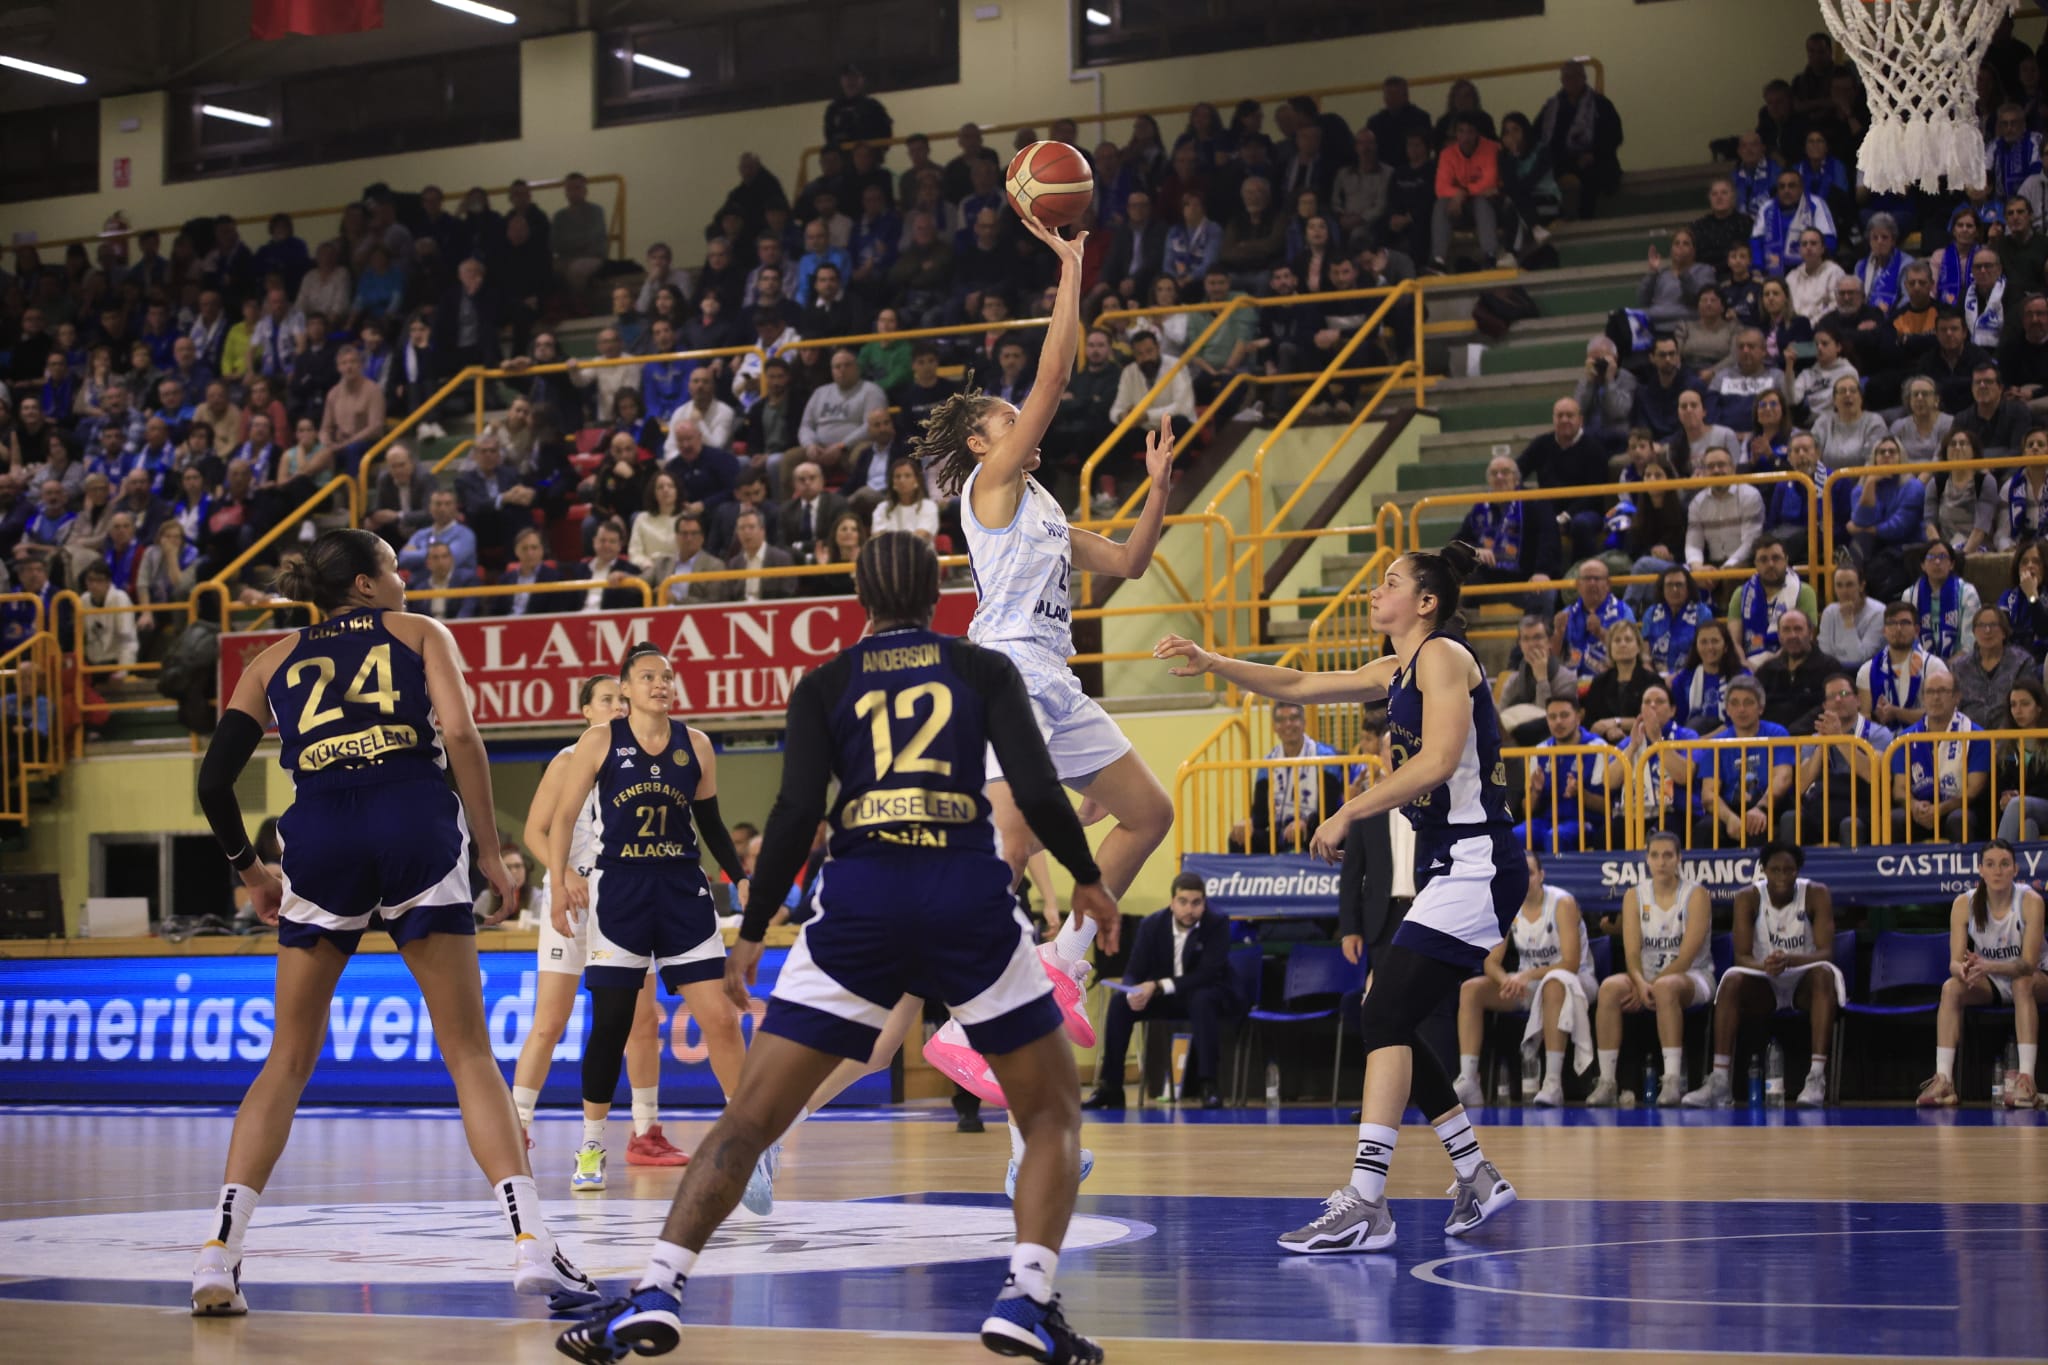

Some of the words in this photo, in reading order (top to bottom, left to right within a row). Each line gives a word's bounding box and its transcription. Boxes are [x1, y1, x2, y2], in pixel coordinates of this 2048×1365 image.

[862, 642, 941, 673] ANDERSON
[286, 643, 400, 735] 24
[706, 664, 807, 709] HUM
[854, 681, 953, 782] 12
[304, 731, 412, 769] YÜKSELEN
[636, 805, 668, 837] 21
[1601, 857, 1768, 886] SALMANCA
[1877, 853, 1984, 877] CASTILL
[2024, 850, 2044, 877] Y
[1205, 869, 1341, 897] erfumeriasa
